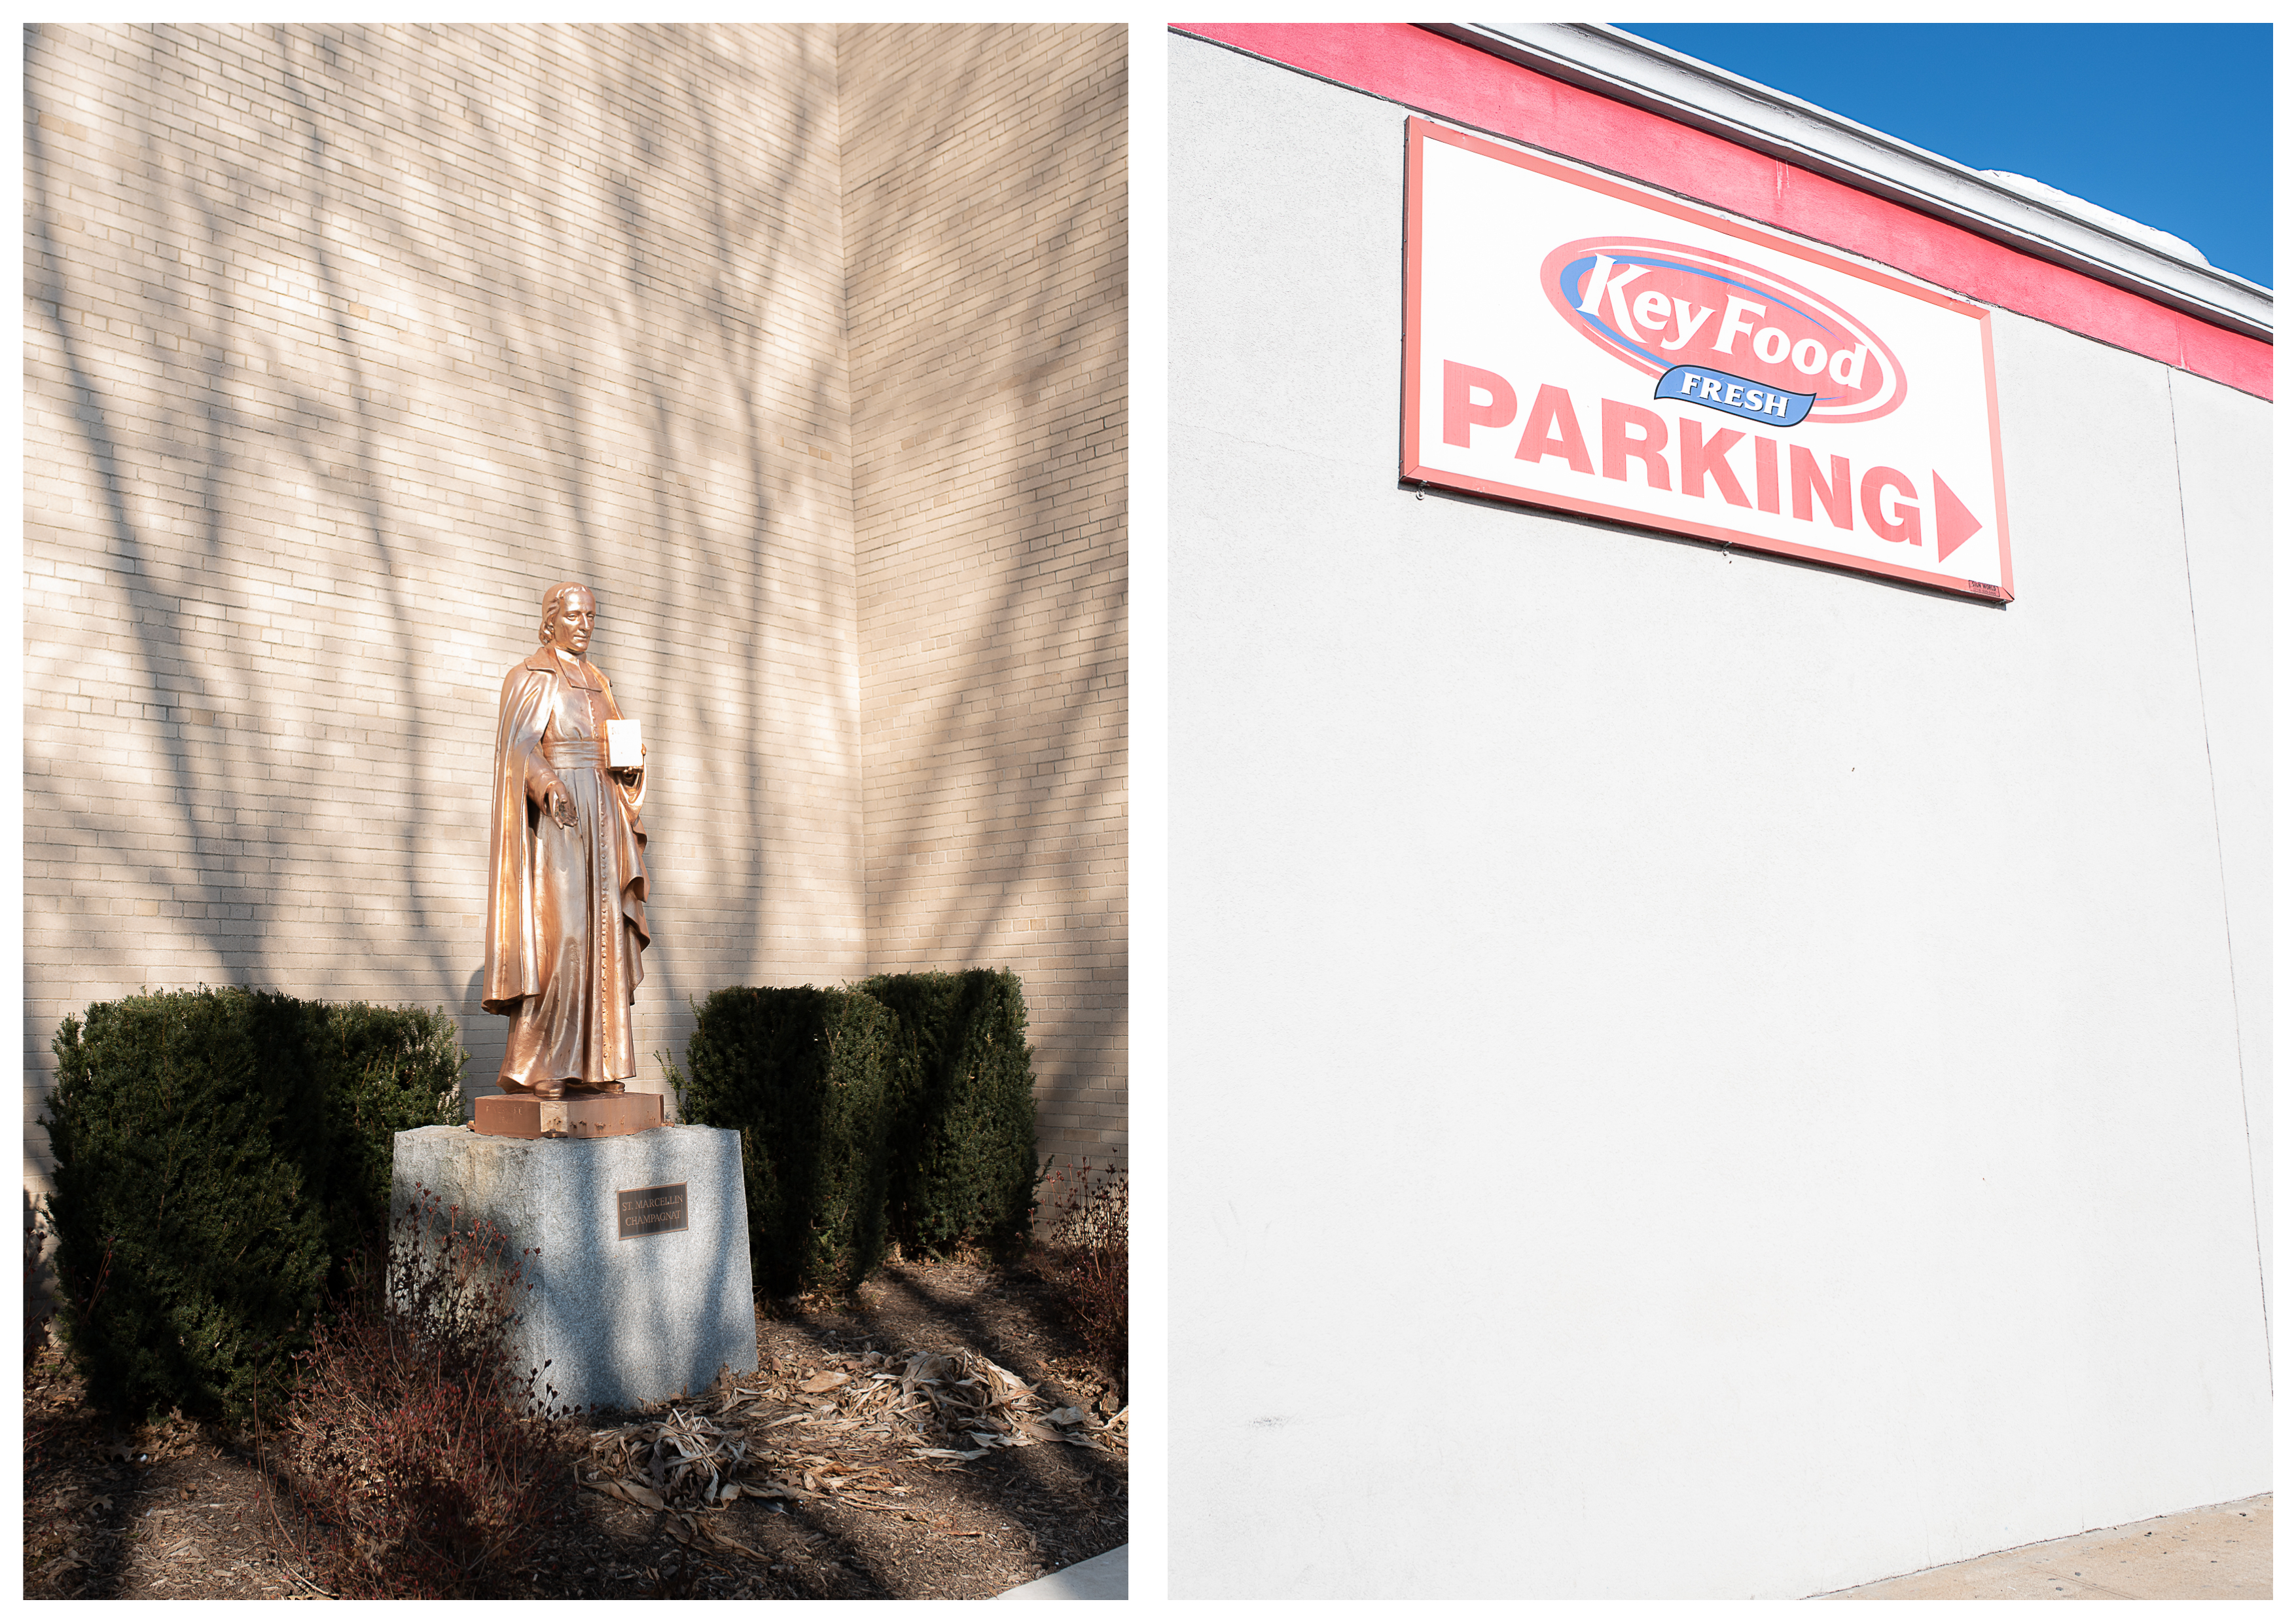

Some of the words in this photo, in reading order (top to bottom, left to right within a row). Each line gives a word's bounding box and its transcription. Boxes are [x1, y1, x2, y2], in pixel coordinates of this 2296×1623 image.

[1575, 253, 1717, 350] Key
[1708, 293, 1868, 390] Food
[1676, 371, 1792, 419] FRESH
[1443, 359, 1922, 547] PARKING
[622, 1201, 634, 1211] ST.
[635, 1195, 683, 1209] MARCELLIN
[625, 1210, 681, 1226] CHAMPAGNAT
